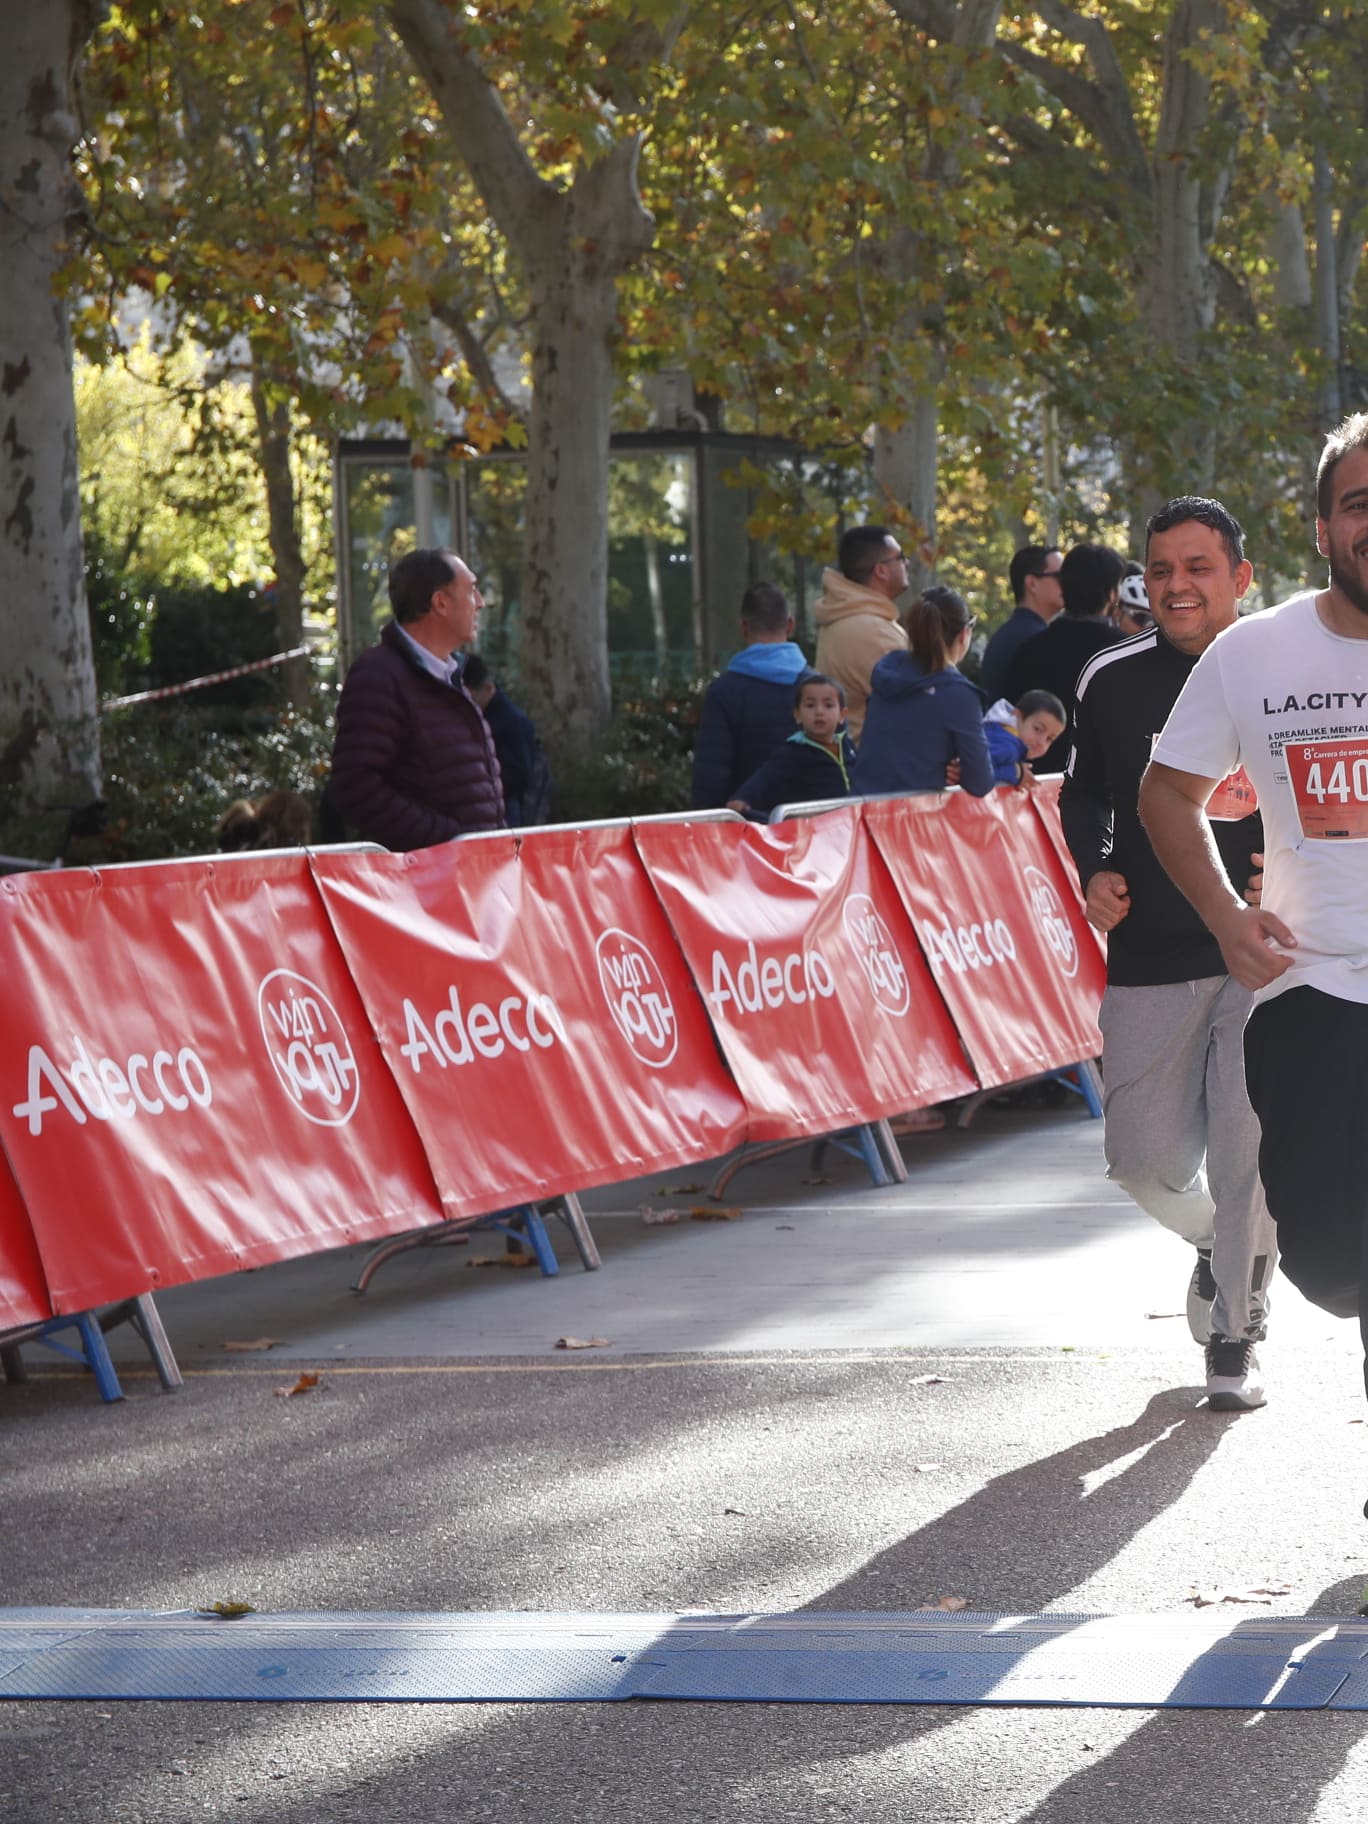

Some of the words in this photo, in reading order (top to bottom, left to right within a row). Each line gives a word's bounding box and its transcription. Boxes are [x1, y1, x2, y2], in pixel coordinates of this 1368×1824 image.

[1263, 692, 1368, 715] L.A.CITY
[1273, 727, 1327, 740] DREAMLIKE
[1314, 750, 1338, 759] Carrera
[1338, 749, 1348, 757] de
[922, 911, 1017, 977] Adecco
[13, 1034, 213, 1137] Adecco
